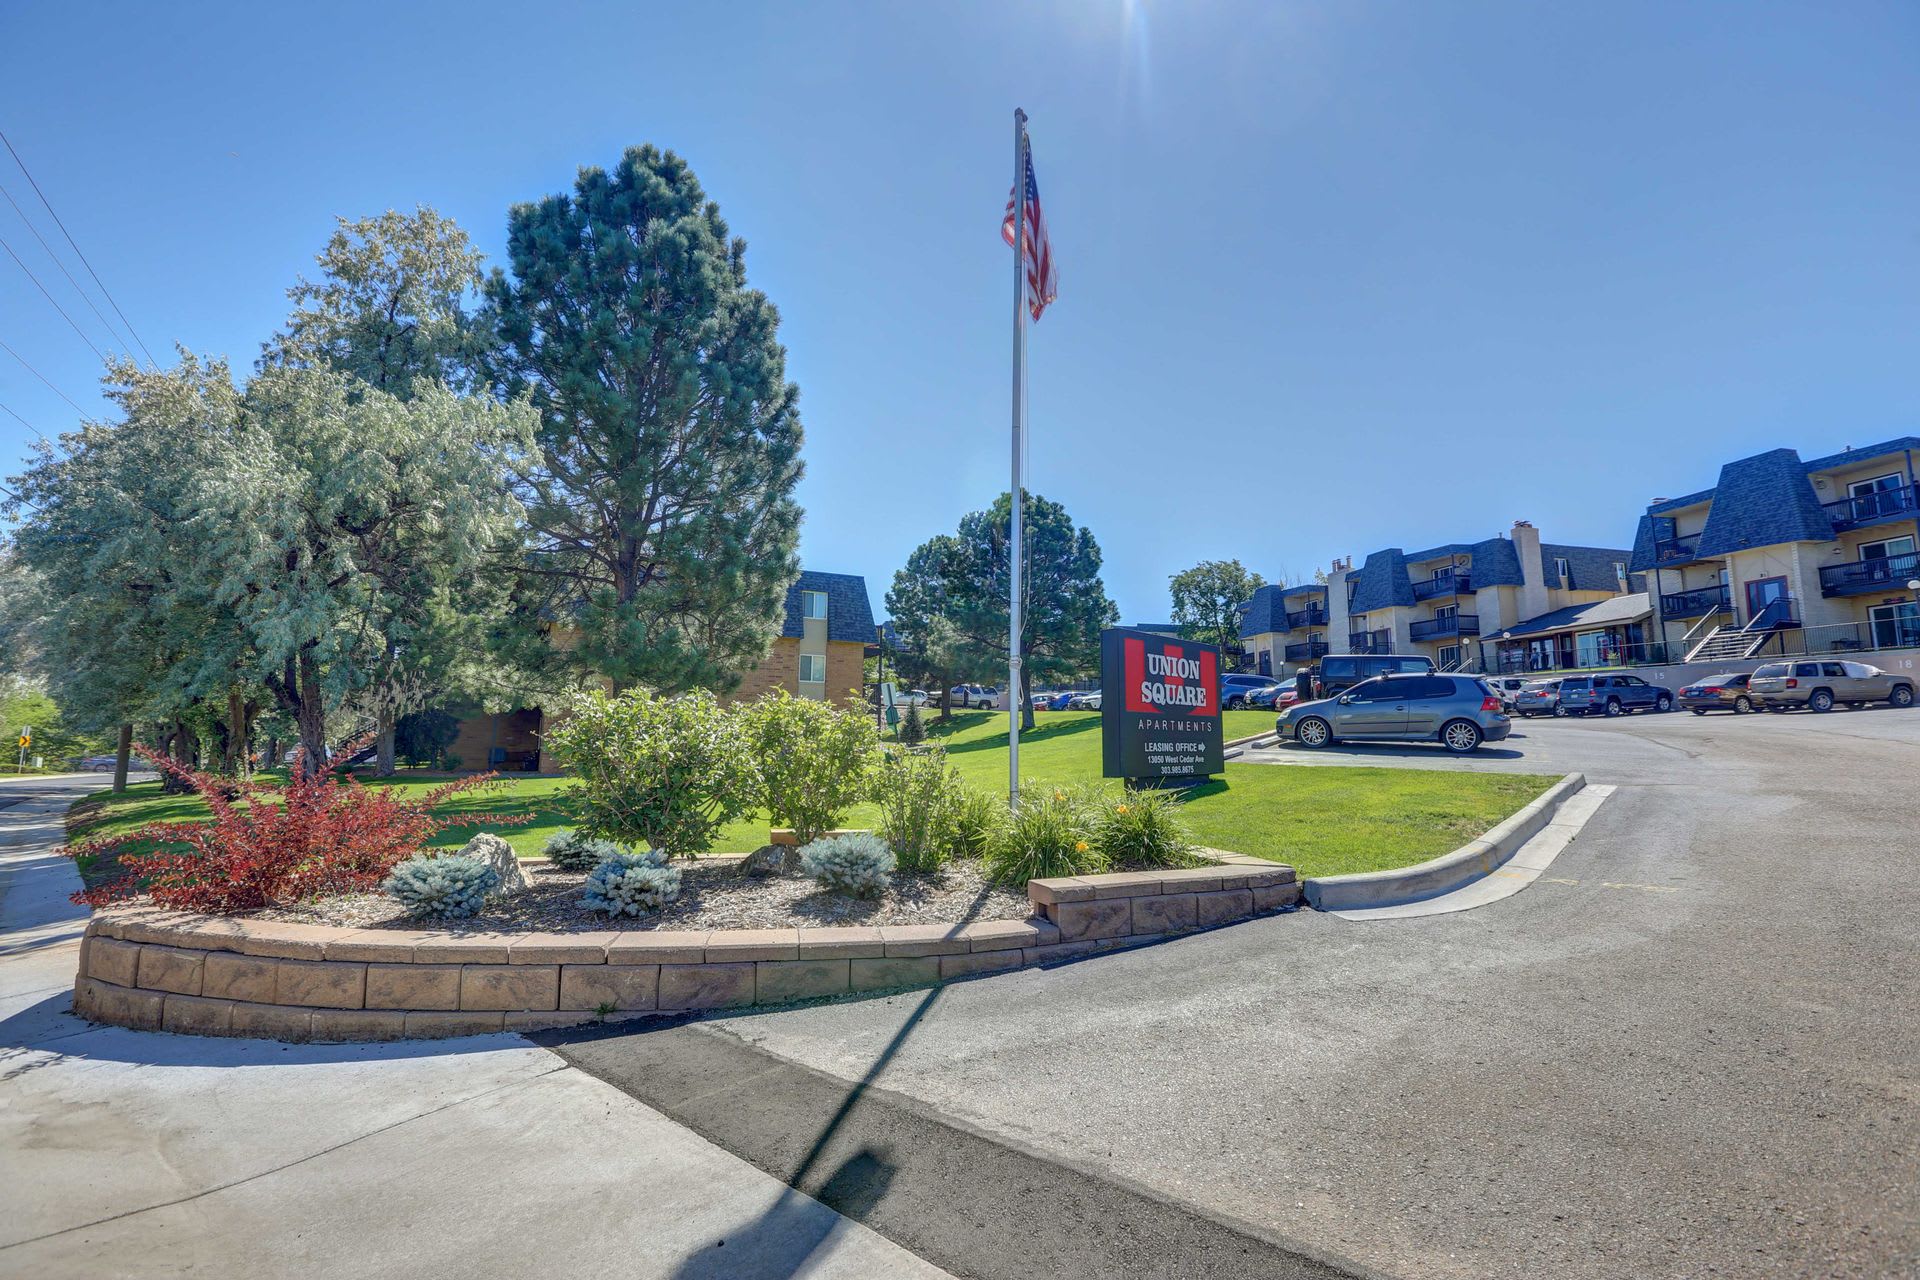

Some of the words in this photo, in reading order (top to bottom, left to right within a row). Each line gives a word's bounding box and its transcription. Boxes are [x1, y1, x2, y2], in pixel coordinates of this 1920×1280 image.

[1147, 653, 1200, 680] UNION
[1899, 659, 1912, 669] 18
[1655, 672, 1665, 680] 15
[1141, 681, 1207, 707] SQUARE
[1138, 719, 1212, 732] APARTMENTS
[1144, 742, 1174, 752] LEASING
[1175, 742, 1197, 752] OFFICE
[1164, 755, 1179, 764] West
[1179, 754, 1194, 763] Cedar
[1194, 754, 1205, 763] Ave
